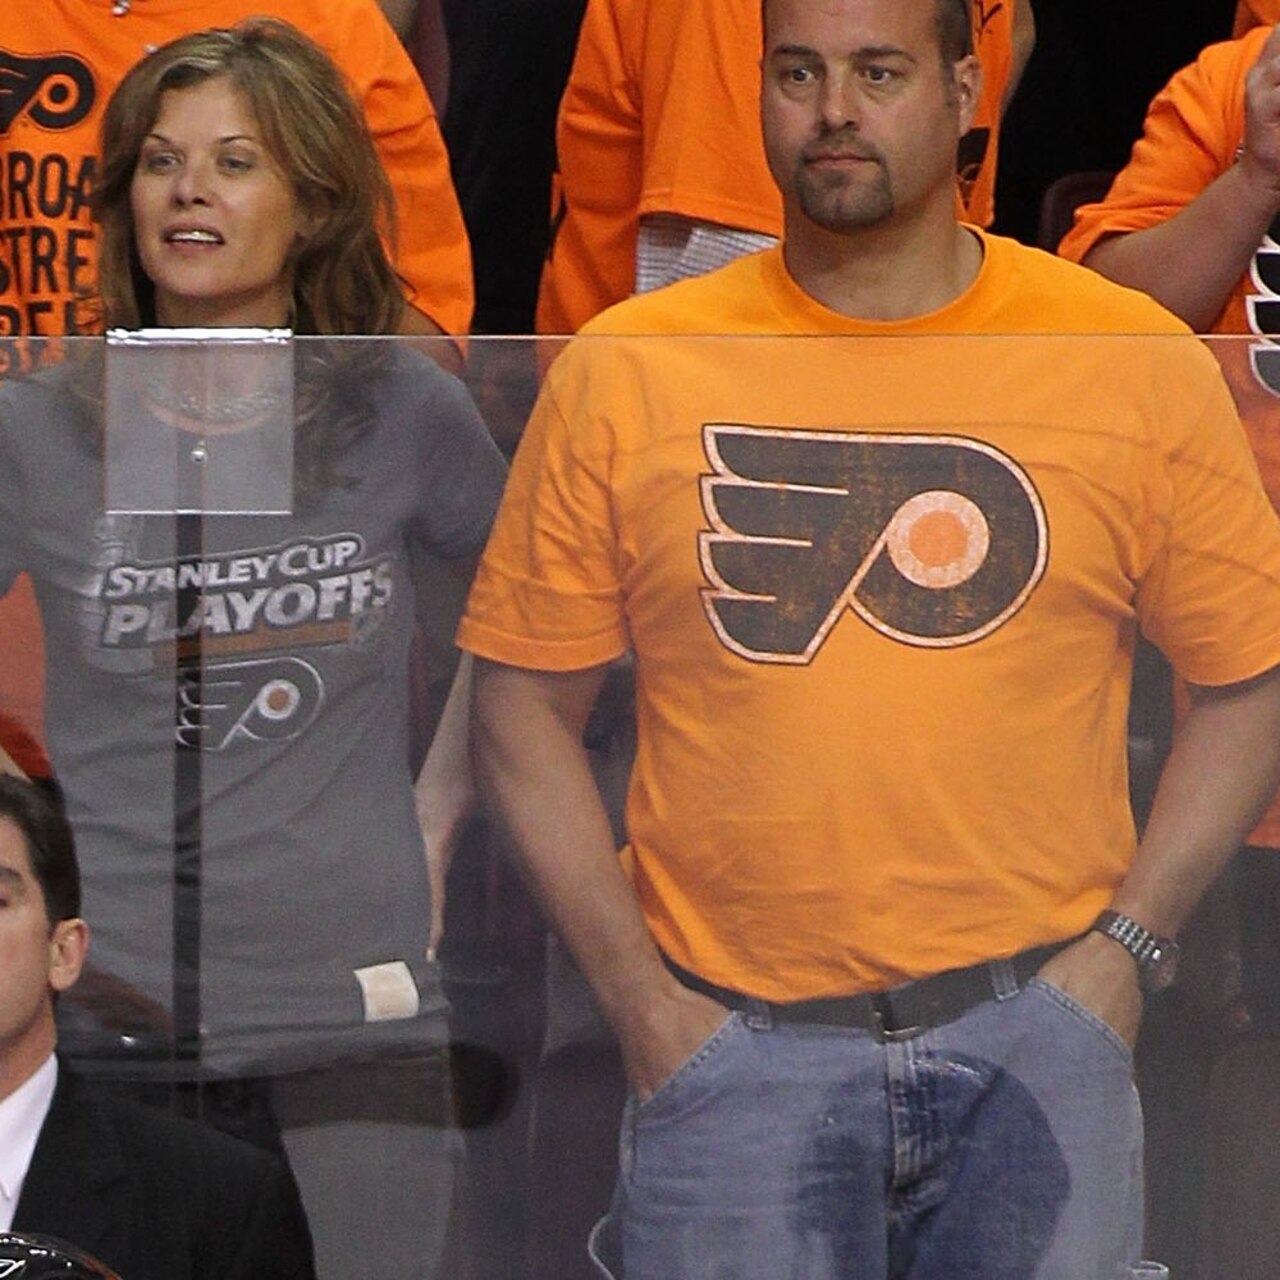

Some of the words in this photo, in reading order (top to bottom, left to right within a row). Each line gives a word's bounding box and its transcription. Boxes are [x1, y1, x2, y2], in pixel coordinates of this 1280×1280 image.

[102, 560, 392, 645] PLAYOFFS
[106, 554, 277, 597] STANLEY
[278, 540, 360, 576] CUP
